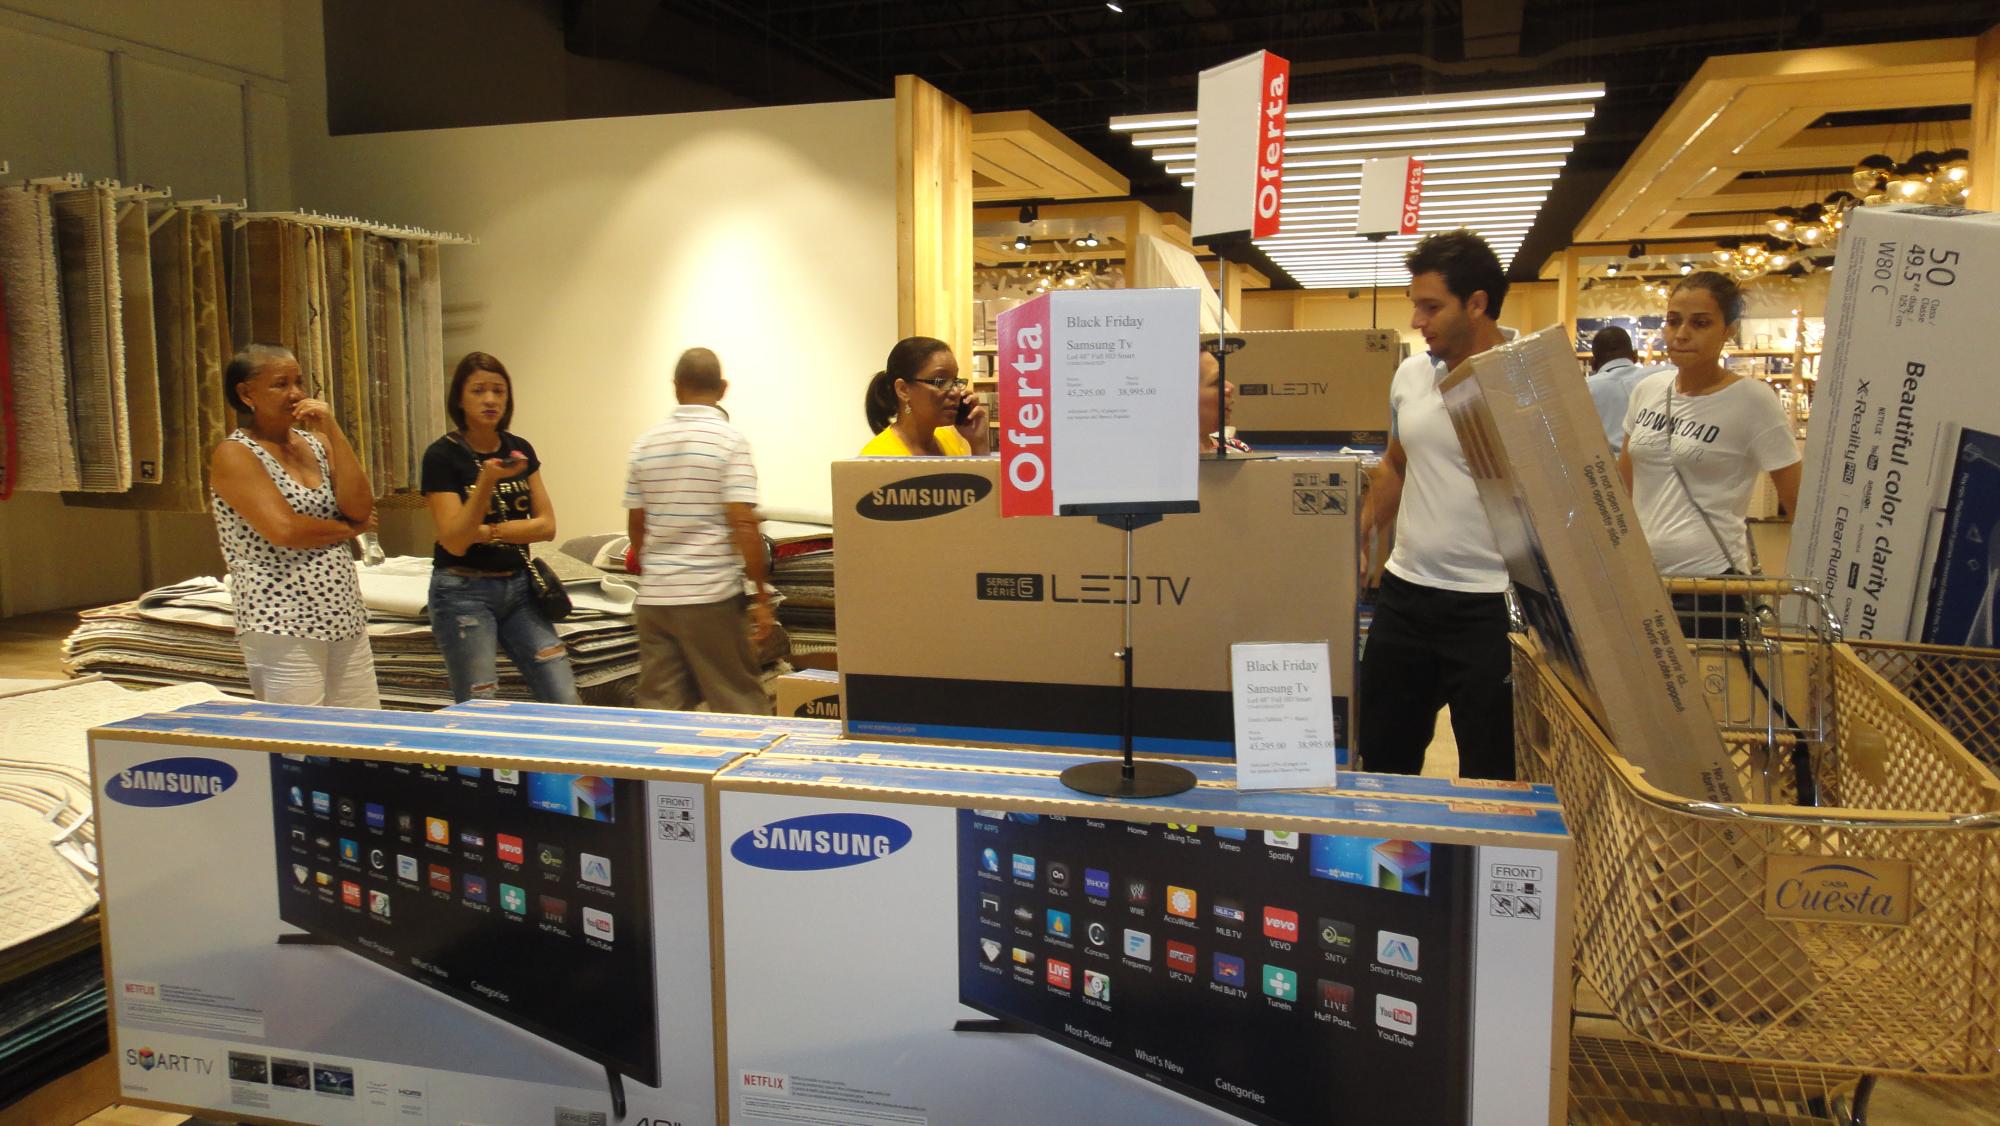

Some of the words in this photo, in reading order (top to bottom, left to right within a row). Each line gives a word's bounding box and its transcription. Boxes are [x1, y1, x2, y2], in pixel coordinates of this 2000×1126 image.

[1258, 73, 1285, 219] Oferta
[1403, 166, 1423, 227] Oferta
[1874, 241, 1898, 280] W80
[1926, 248, 1960, 287] 50
[1871, 284, 1889, 296] C
[1918, 297, 1929, 323] Classe
[1928, 298, 1941, 320] Class
[1066, 316, 1101, 328] Black
[1105, 314, 1144, 330] Friday
[1895, 316, 1903, 327] cm
[1066, 339, 1116, 352] Samsung
[1118, 338, 1133, 350] Tv
[1270, 383, 1308, 396] LED
[1312, 382, 1329, 395] TV
[1008, 323, 1046, 492] Oferta
[1890, 360, 1925, 466] Beautiful
[1635, 407, 1720, 444] DOWNLOAD
[1843, 377, 1871, 460] X-Reality
[1874, 406, 1887, 436] NETFLIX
[1594, 460, 1606, 474] Do
[1842, 462, 1857, 485] PRO
[1600, 474, 1613, 490] not
[872, 486, 977, 507] SAMSUNG
[1583, 464, 1599, 488] Open
[1592, 489, 1614, 526] opposite
[1606, 490, 1620, 513] open
[1876, 468, 1903, 528] color,
[1823, 505, 1849, 600] ClearAudio+
[1862, 535, 1893, 601] clarity
[985, 577, 1015, 587] SERIES
[1017, 577, 1034, 598] 5
[985, 587, 1017, 597] SÉRIE
[1051, 574, 1141, 604] LED
[1146, 576, 1191, 606] TV
[1653, 614, 1665, 628] Ne
[1642, 618, 1659, 646] Ouvrir
[1653, 646, 1664, 660] du
[1658, 628, 1672, 646] pas
[1246, 660, 1280, 672] Black
[1283, 659, 1319, 674] Friday
[1665, 645, 1682, 673] ouvrir
[1247, 683, 1293, 696] Samsung
[1296, 682, 1309, 693] Tv
[120, 769, 223, 796] SAMSUNG
[659, 797, 691, 807] FRONT
[1086, 818, 1106, 829] Search
[1127, 825, 1148, 836] Home
[753, 825, 890, 858] SAMSUNG
[1163, 831, 1186, 845] Talking
[1186, 835, 1201, 846] Tom
[1218, 841, 1241, 852] Vimeo
[1268, 849, 1295, 863] Spotify
[1052, 869, 1064, 880] On
[1494, 866, 1538, 879] FRONT
[576, 881, 596, 893] Smart
[596, 885, 616, 898] Home
[1775, 878, 1893, 917] Cuesta
[1129, 906, 1145, 917] WWE
[1265, 917, 1297, 932] vevo
[1269, 939, 1292, 951] VEVO
[1121, 957, 1153, 973] Frequency
[1324, 952, 1348, 965] SNTV
[1049, 962, 1070, 979] LIVE
[1369, 963, 1395, 978] Smart
[1396, 969, 1423, 984] Home
[125, 983, 155, 996] NETFLIX
[1210, 982, 1223, 994] Red
[1223, 985, 1238, 997] Bull
[1237, 989, 1248, 1000] TV
[1267, 997, 1293, 1012] TuneIn
[1324, 999, 1349, 1013] LIVE
[1313, 1010, 1332, 1022] Huff
[1064, 1022, 1084, 1039] Most
[1083, 1029, 1114, 1049] Popular
[1377, 1029, 1415, 1048] YouTube
[193, 1056, 214, 1076] TV
[1134, 1048, 1165, 1068] What's
[1163, 1058, 1185, 1075] New
[743, 1073, 785, 1091] NETFLIX
[1214, 1077, 1266, 1104] Categories
[558, 1110, 588, 1125] SERIES
